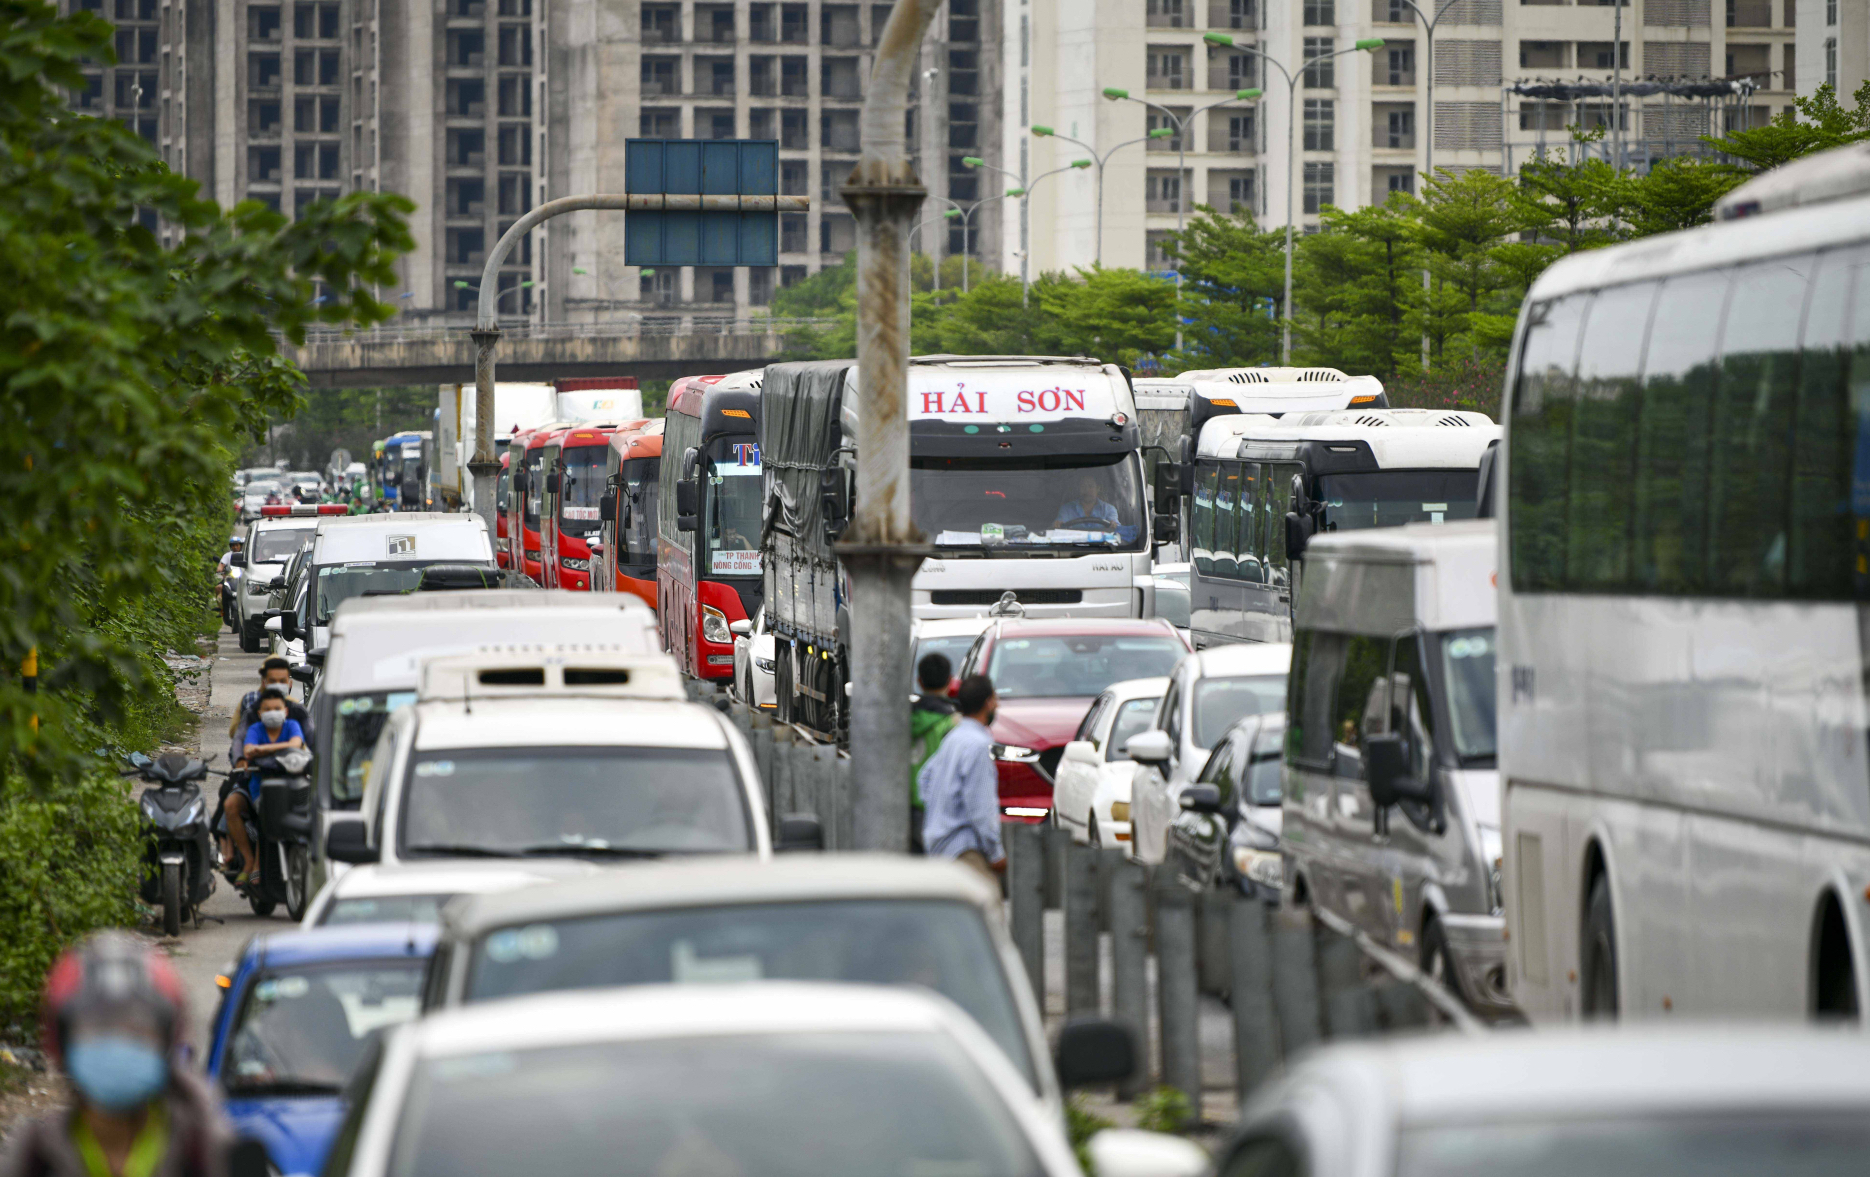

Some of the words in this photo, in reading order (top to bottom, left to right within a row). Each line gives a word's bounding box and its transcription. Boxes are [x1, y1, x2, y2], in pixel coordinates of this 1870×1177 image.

[921, 382, 988, 413] HẢI
[1017, 386, 1086, 413] SƠN
[726, 552, 735, 560] TP
[736, 551, 760, 560] THANH
[713, 559, 732, 570] NÔNG
[733, 559, 752, 570] CỐNG
